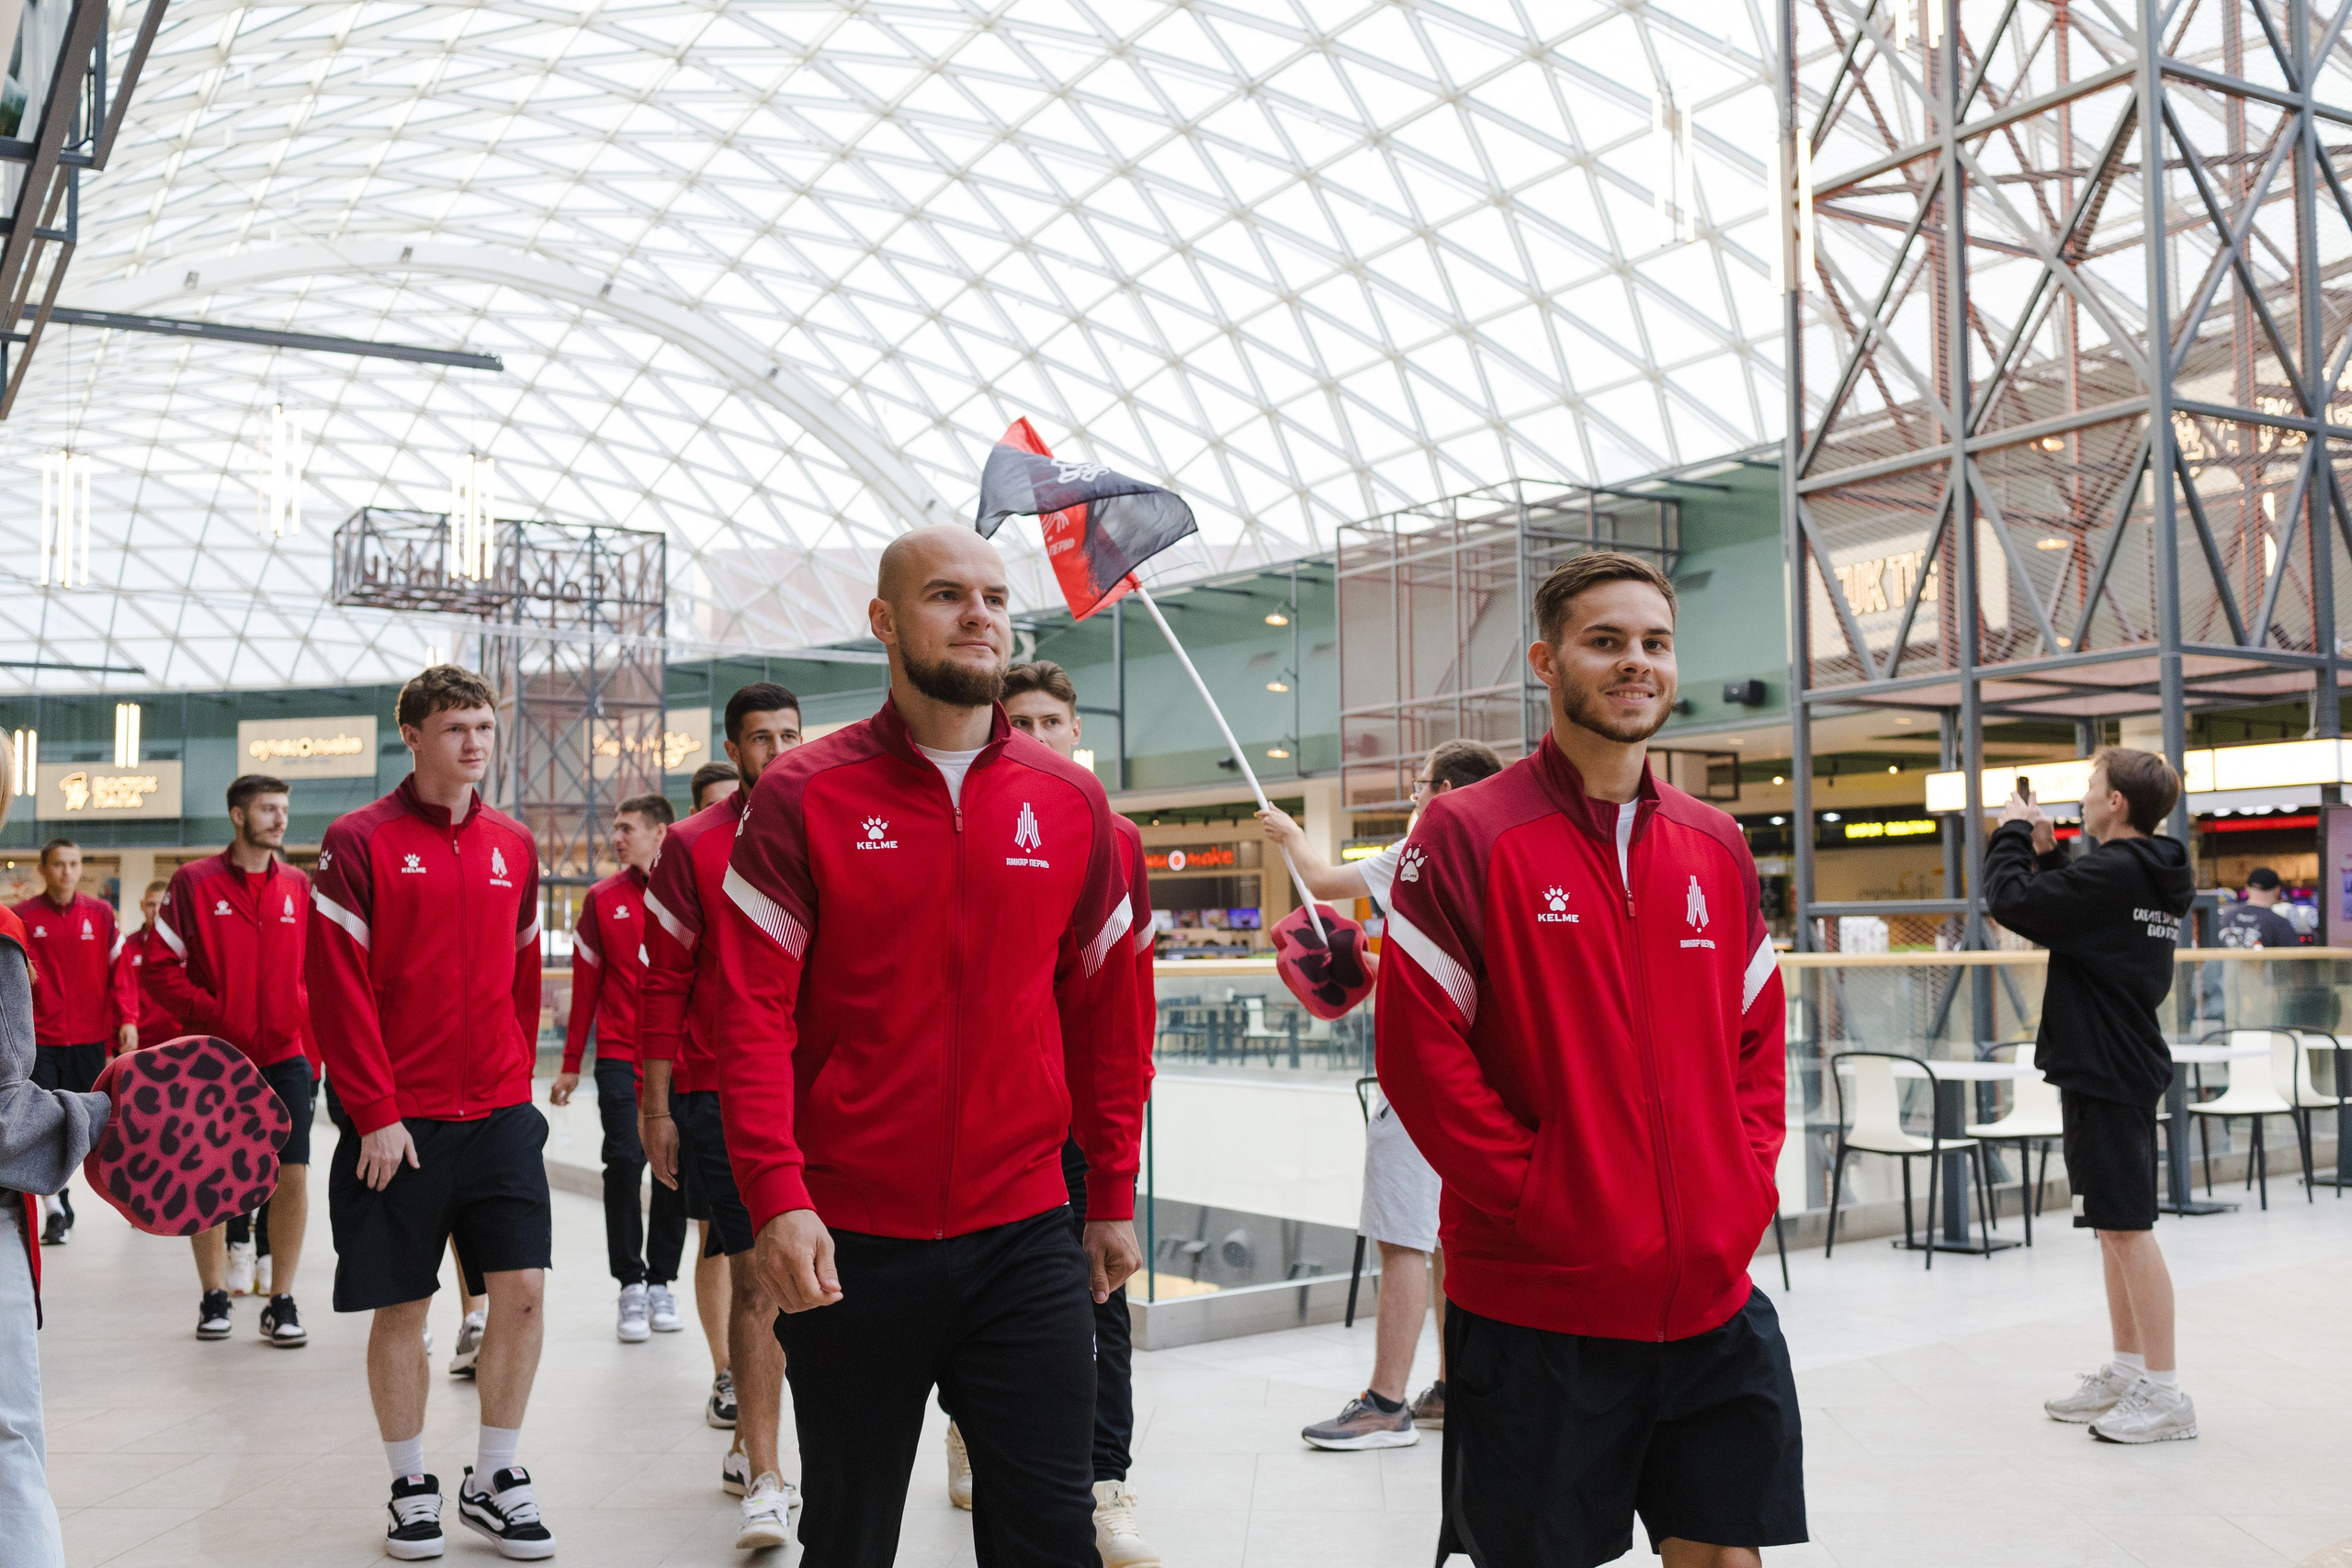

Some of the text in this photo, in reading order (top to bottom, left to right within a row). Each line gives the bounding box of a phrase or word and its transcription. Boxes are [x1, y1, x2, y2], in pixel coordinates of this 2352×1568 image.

[856, 840, 899, 851] KELME
[1029, 858, 1049, 868] ПЕРМЬ
[1537, 913, 1579, 923] KELME
